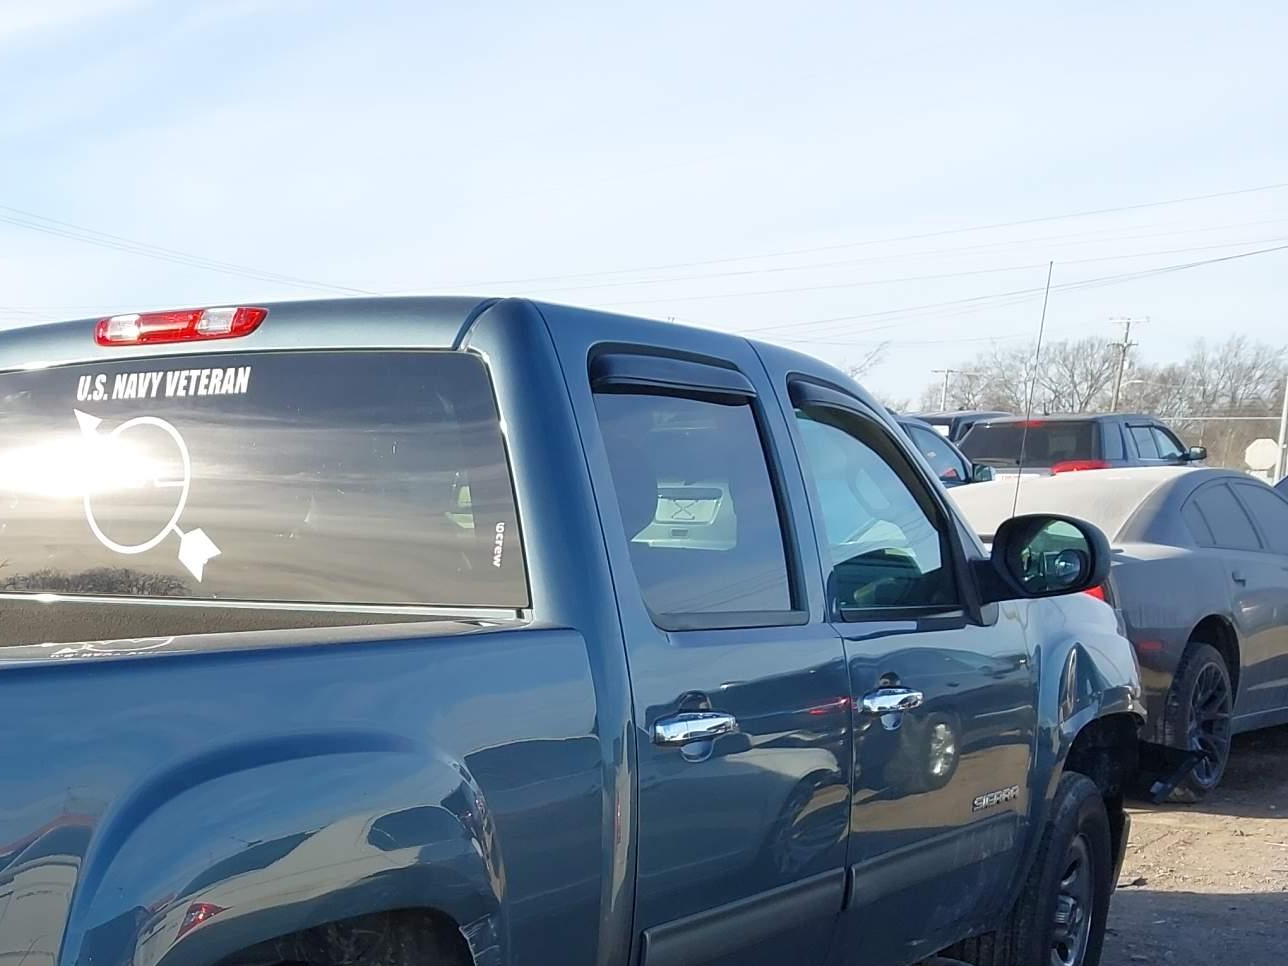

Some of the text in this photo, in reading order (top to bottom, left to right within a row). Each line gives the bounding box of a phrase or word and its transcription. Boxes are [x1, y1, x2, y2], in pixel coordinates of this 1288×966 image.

[76, 366, 252, 401] U.S. NAVY VETERAN
[973, 785, 1019, 811] SIERRA
